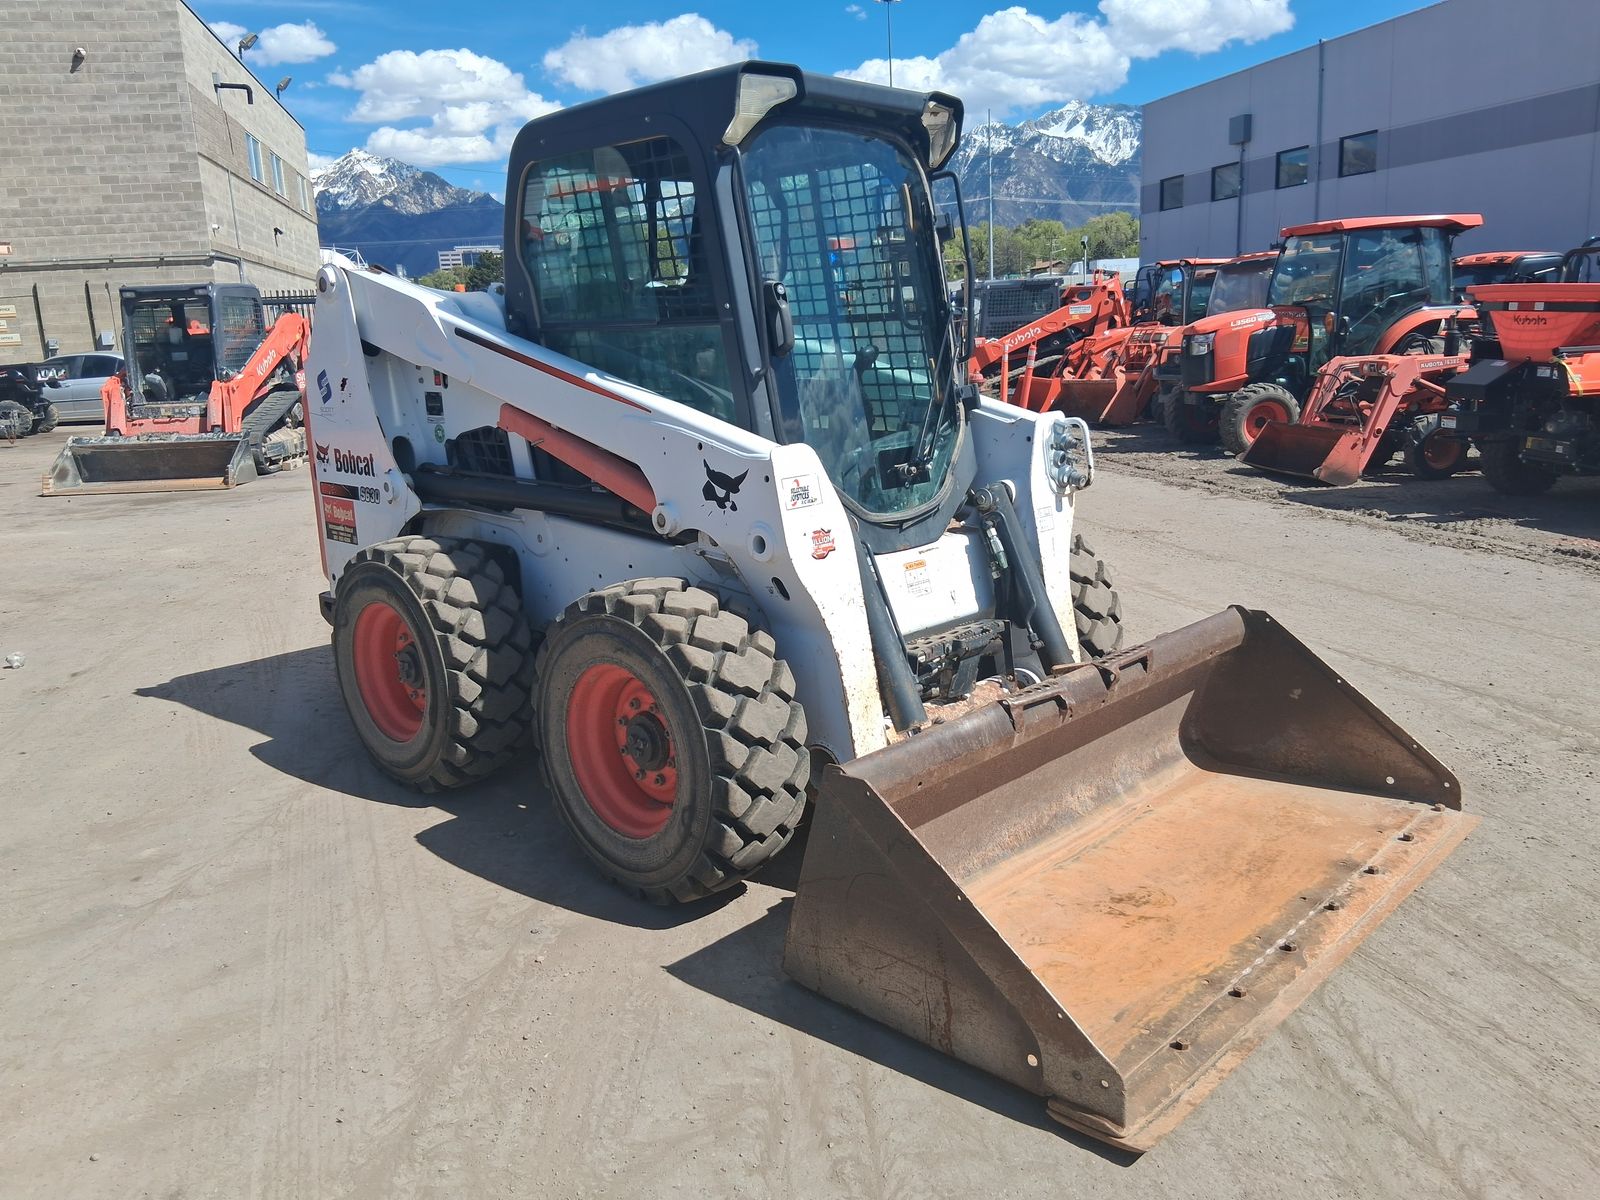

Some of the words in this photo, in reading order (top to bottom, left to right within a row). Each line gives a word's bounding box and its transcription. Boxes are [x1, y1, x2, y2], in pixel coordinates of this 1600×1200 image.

[1230, 316, 1257, 326] L3560
[1513, 314, 1547, 326] Kubota
[1004, 327, 1042, 348] Kubota
[256, 349, 277, 376] Kubota
[333, 448, 376, 478] Bobcat
[359, 486, 380, 504] S630
